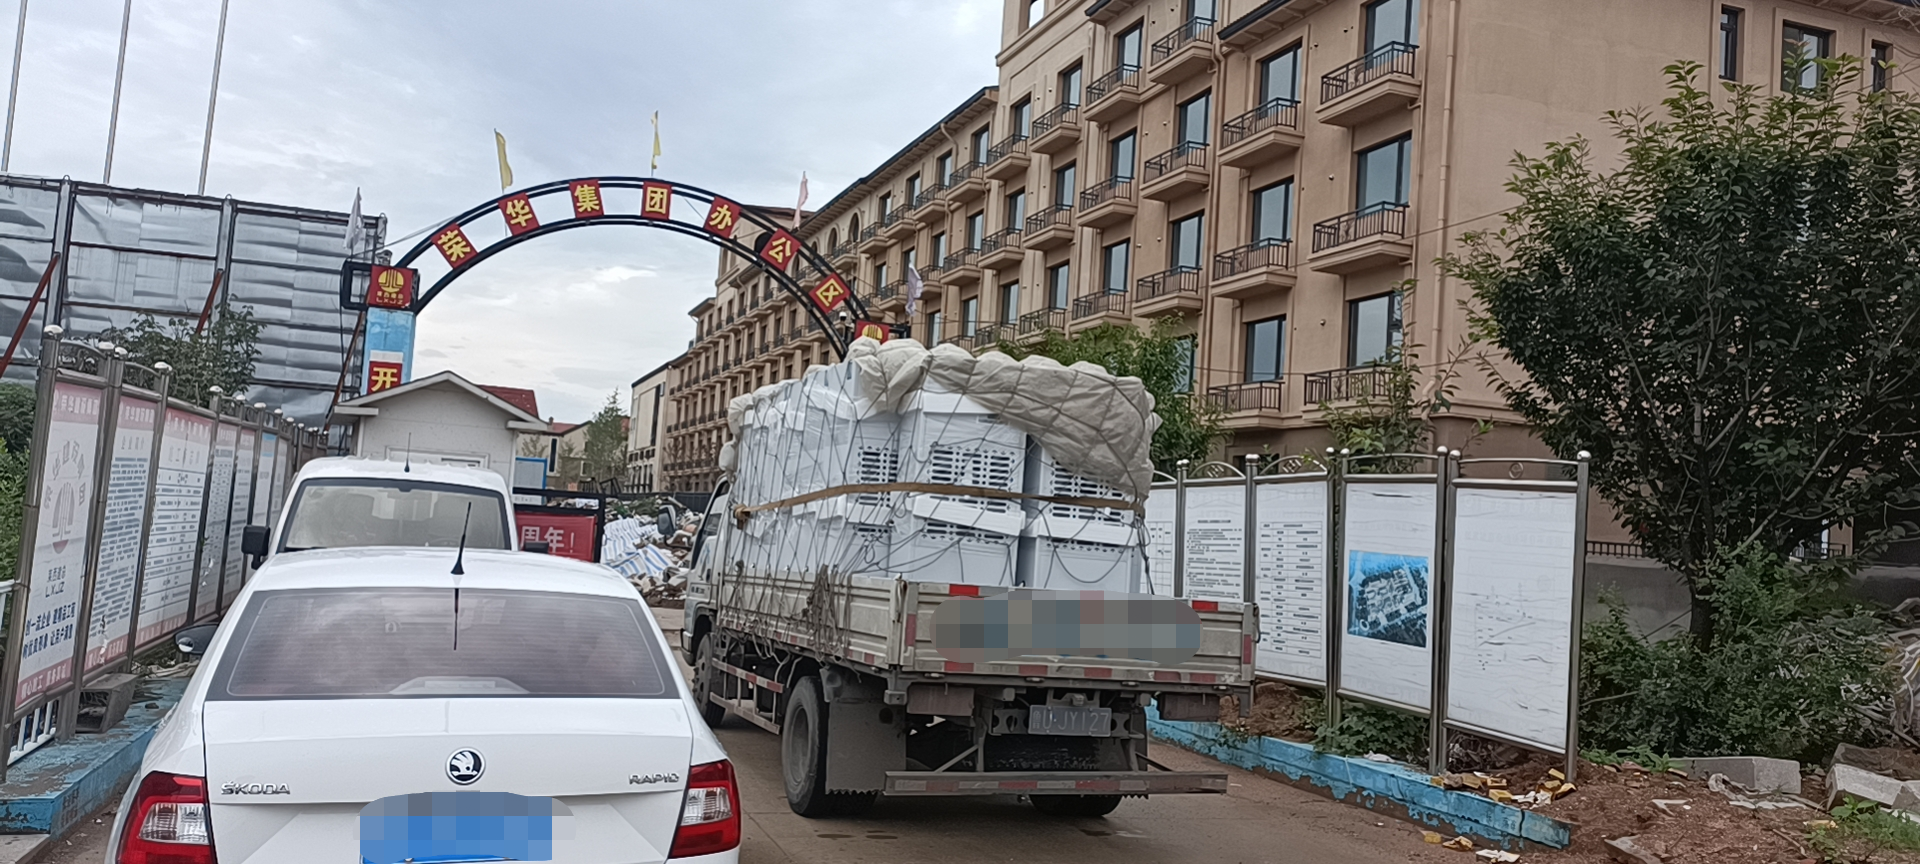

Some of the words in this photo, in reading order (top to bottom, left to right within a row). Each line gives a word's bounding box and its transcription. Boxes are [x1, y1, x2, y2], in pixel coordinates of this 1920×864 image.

[437, 184, 844, 307] 荣华集团办公区
[371, 366, 398, 392] 开
[629, 773, 679, 785] RAPID
